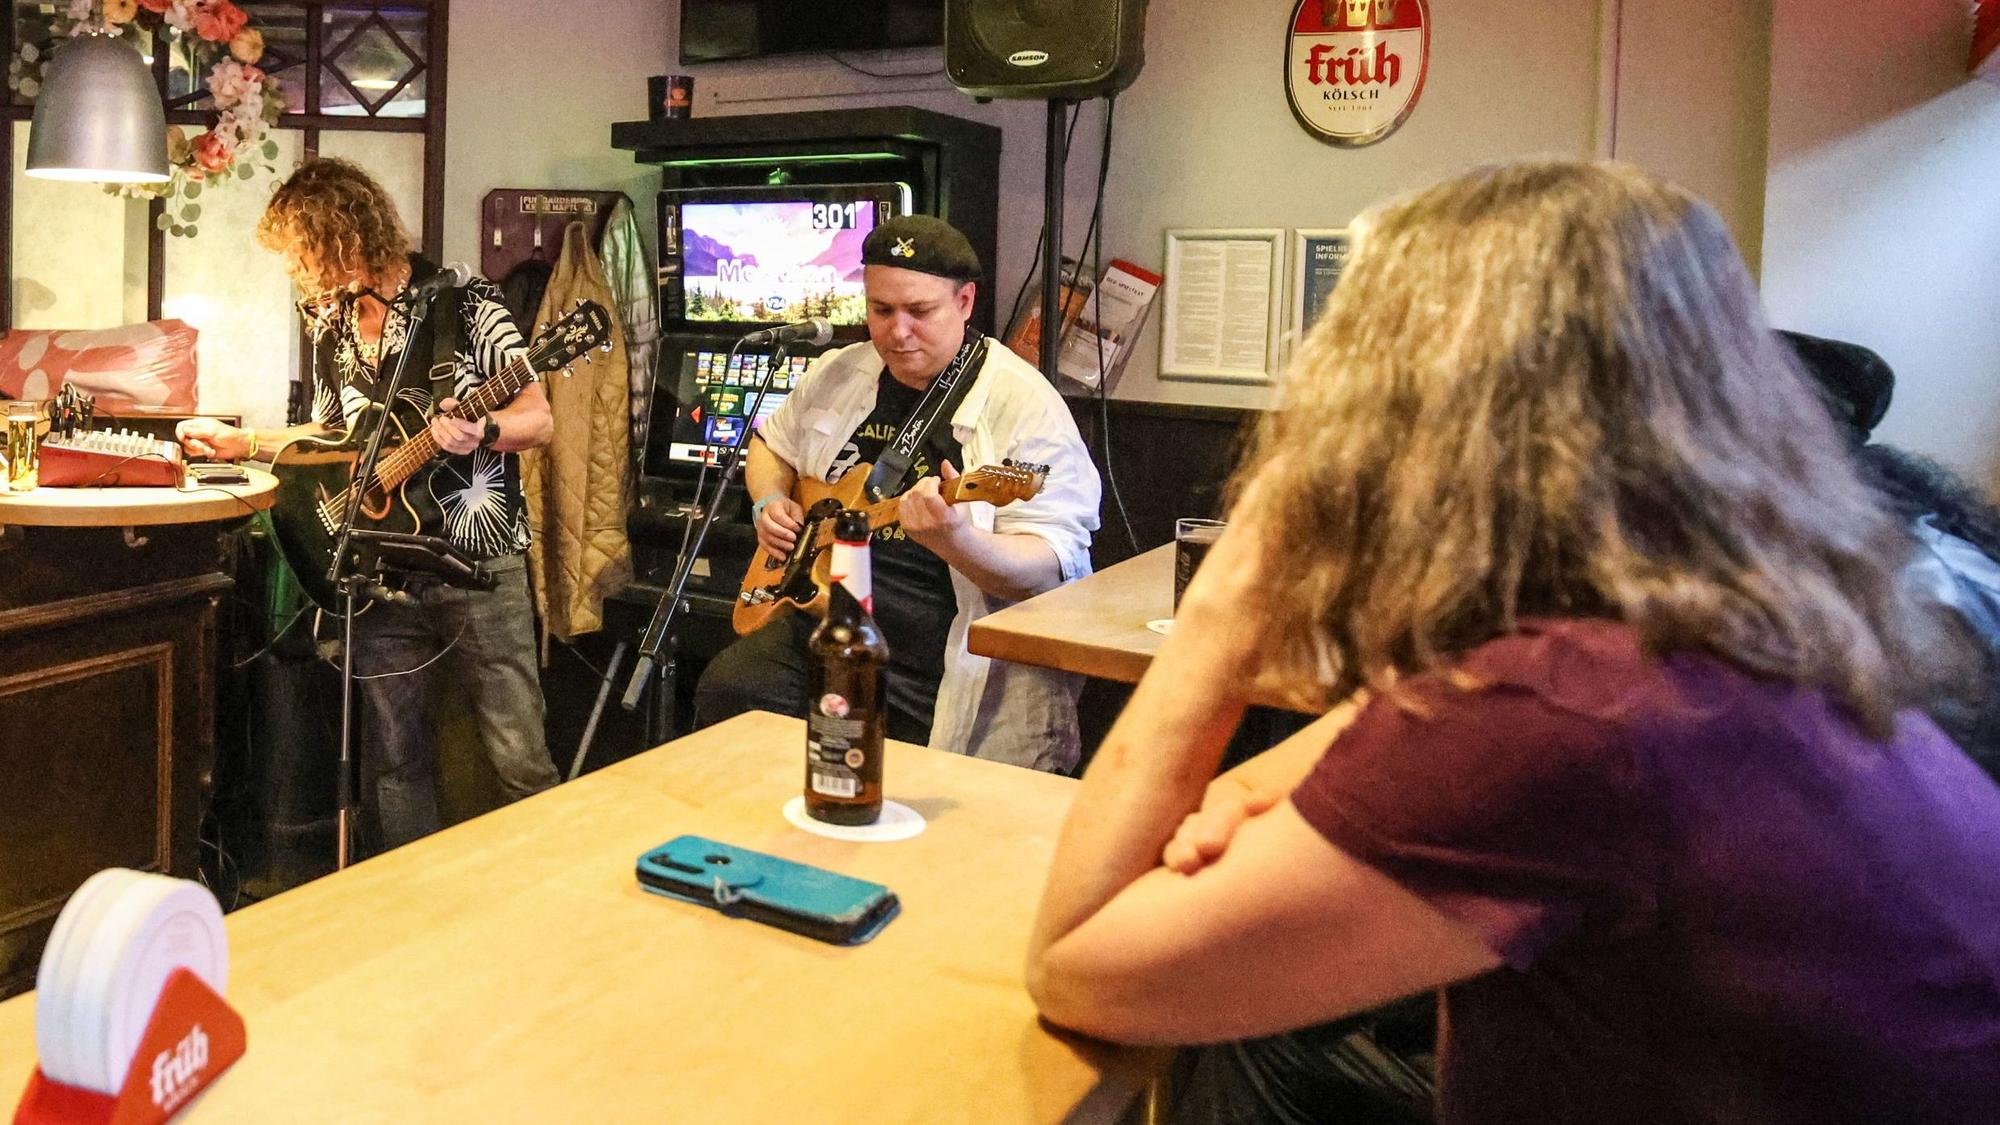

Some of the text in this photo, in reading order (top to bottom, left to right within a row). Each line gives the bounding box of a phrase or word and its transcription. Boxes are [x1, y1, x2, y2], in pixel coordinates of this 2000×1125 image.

[1012, 54, 1046, 62] SAMSON
[1323, 88, 1379, 101] KÖLSCH
[813, 203, 856, 229] 301
